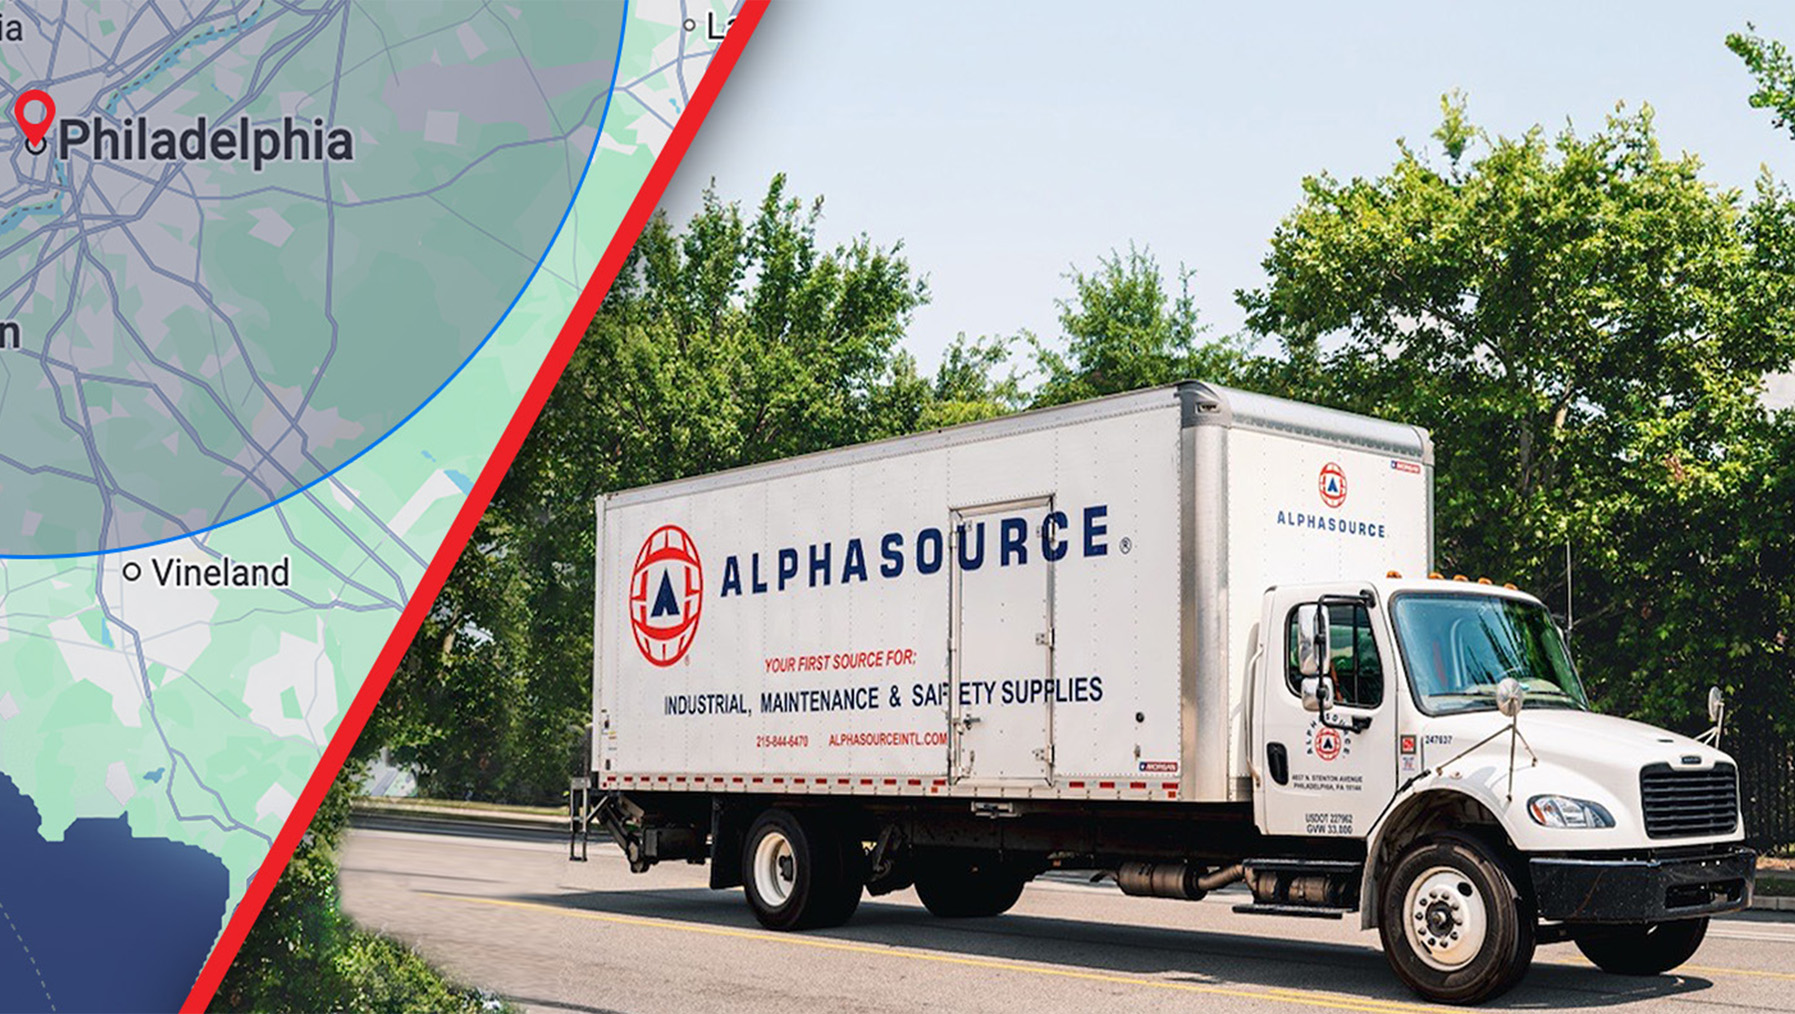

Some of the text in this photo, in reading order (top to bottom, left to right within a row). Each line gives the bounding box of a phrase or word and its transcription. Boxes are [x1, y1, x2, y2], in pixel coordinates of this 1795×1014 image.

[1277, 510, 1385, 538] ALPHASOURCE
[721, 505, 1107, 597] ALPHASOURCE
[765, 657, 796, 673] YOUR
[798, 654, 831, 672] FIRST
[832, 651, 883, 670] SOURCE
[664, 693, 752, 717] INDUSTRIAL,
[761, 687, 879, 713] MAINTENANCE
[889, 685, 902, 708] &
[1001, 676, 1103, 704] SUPPLIES
[756, 731, 948, 749] 215-844-6470 ALPHASOURCEINTL.COM
[1305, 813, 1328, 823] USDOT
[1306, 824, 1326, 834] GVW
